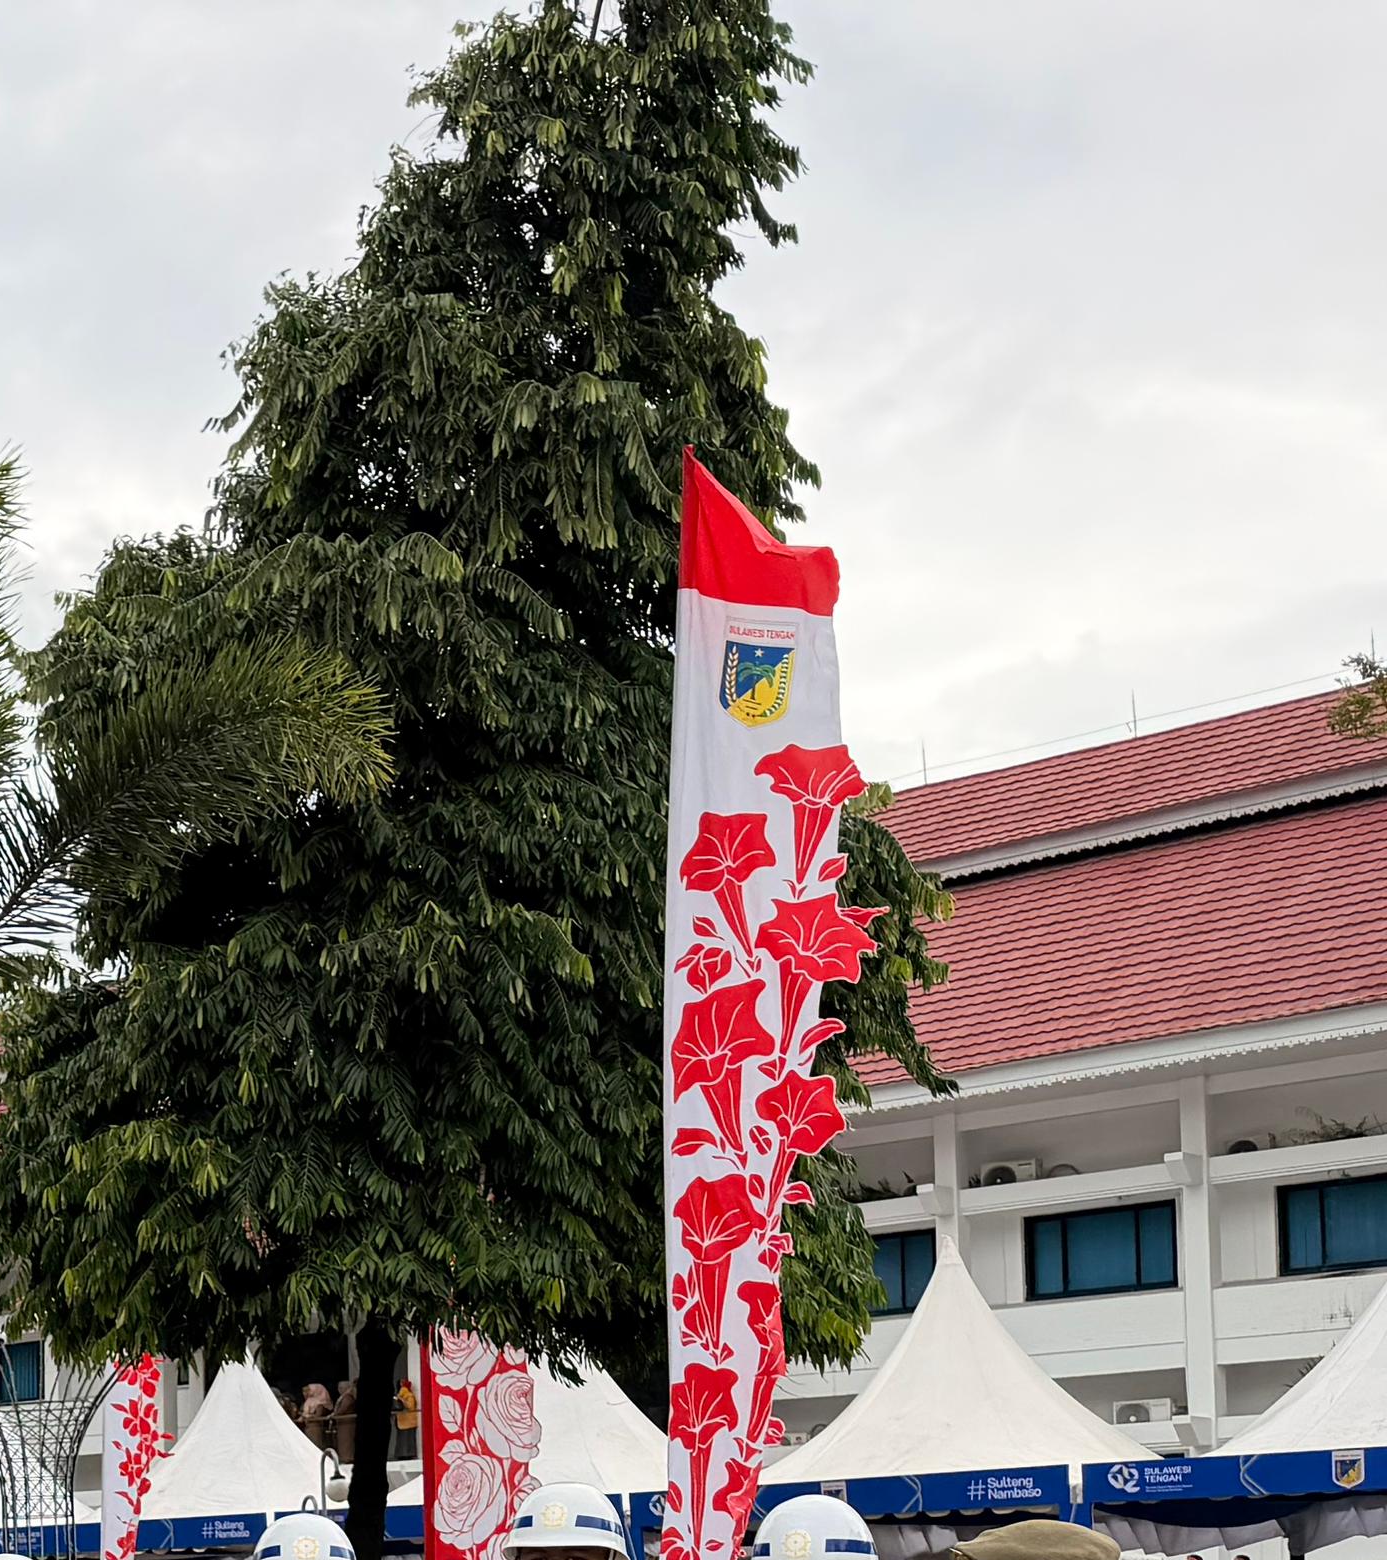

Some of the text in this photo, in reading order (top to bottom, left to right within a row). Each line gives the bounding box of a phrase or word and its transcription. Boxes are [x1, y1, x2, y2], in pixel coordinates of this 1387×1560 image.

[729, 625, 795, 640] SULAWESI TENGAH
[1144, 1465, 1192, 1475] SULAWESI
[1144, 1473, 1183, 1483] TENGAH
[988, 1488, 1042, 1500] Nambaso
